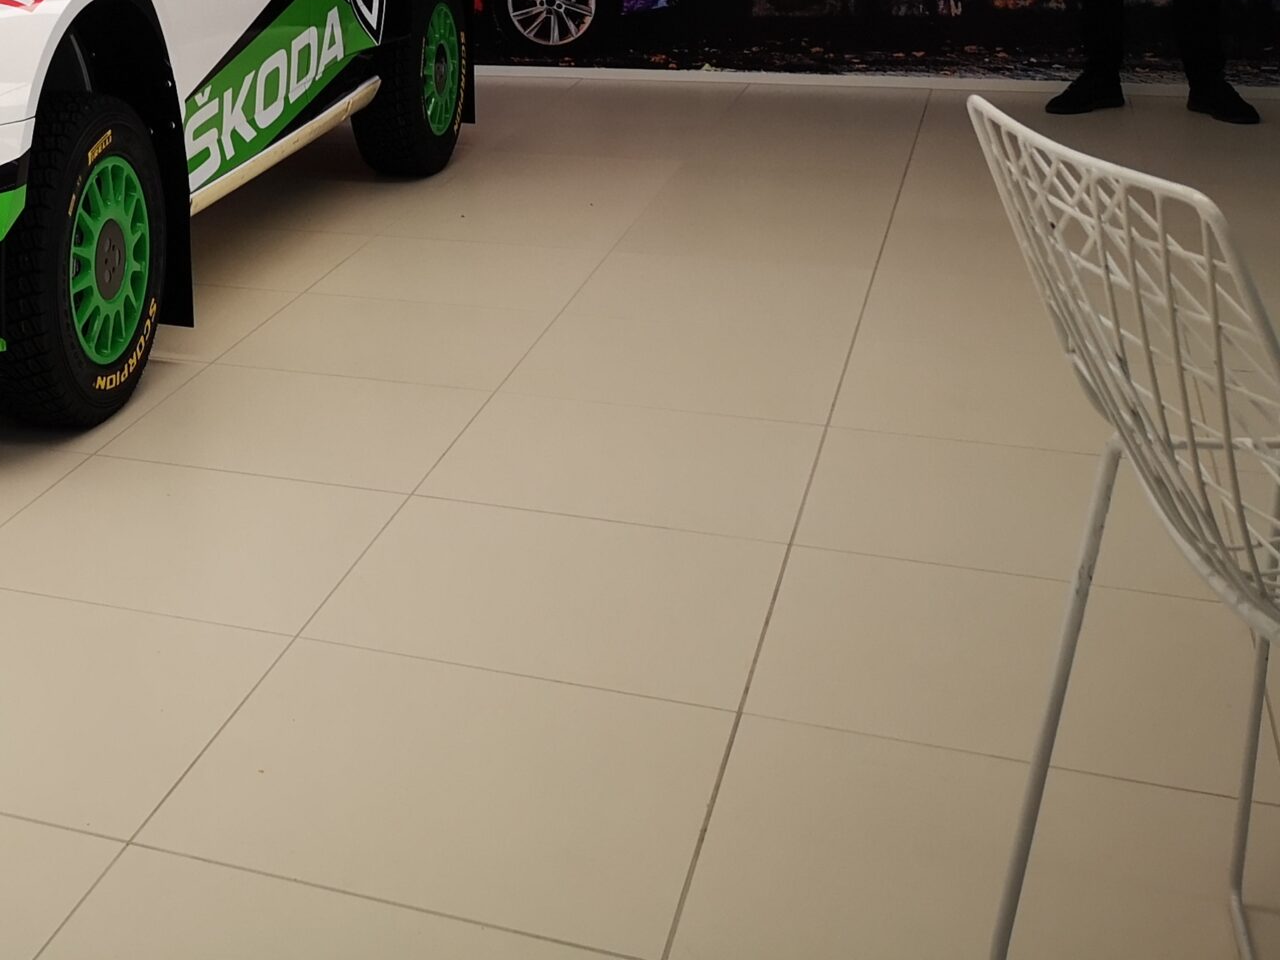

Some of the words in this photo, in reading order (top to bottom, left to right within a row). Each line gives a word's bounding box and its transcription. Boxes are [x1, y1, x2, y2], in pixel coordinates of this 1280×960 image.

[184, 5, 345, 194] ŠKODA
[87, 129, 113, 167] PIRELLI
[95, 297, 158, 391] SCORPION
